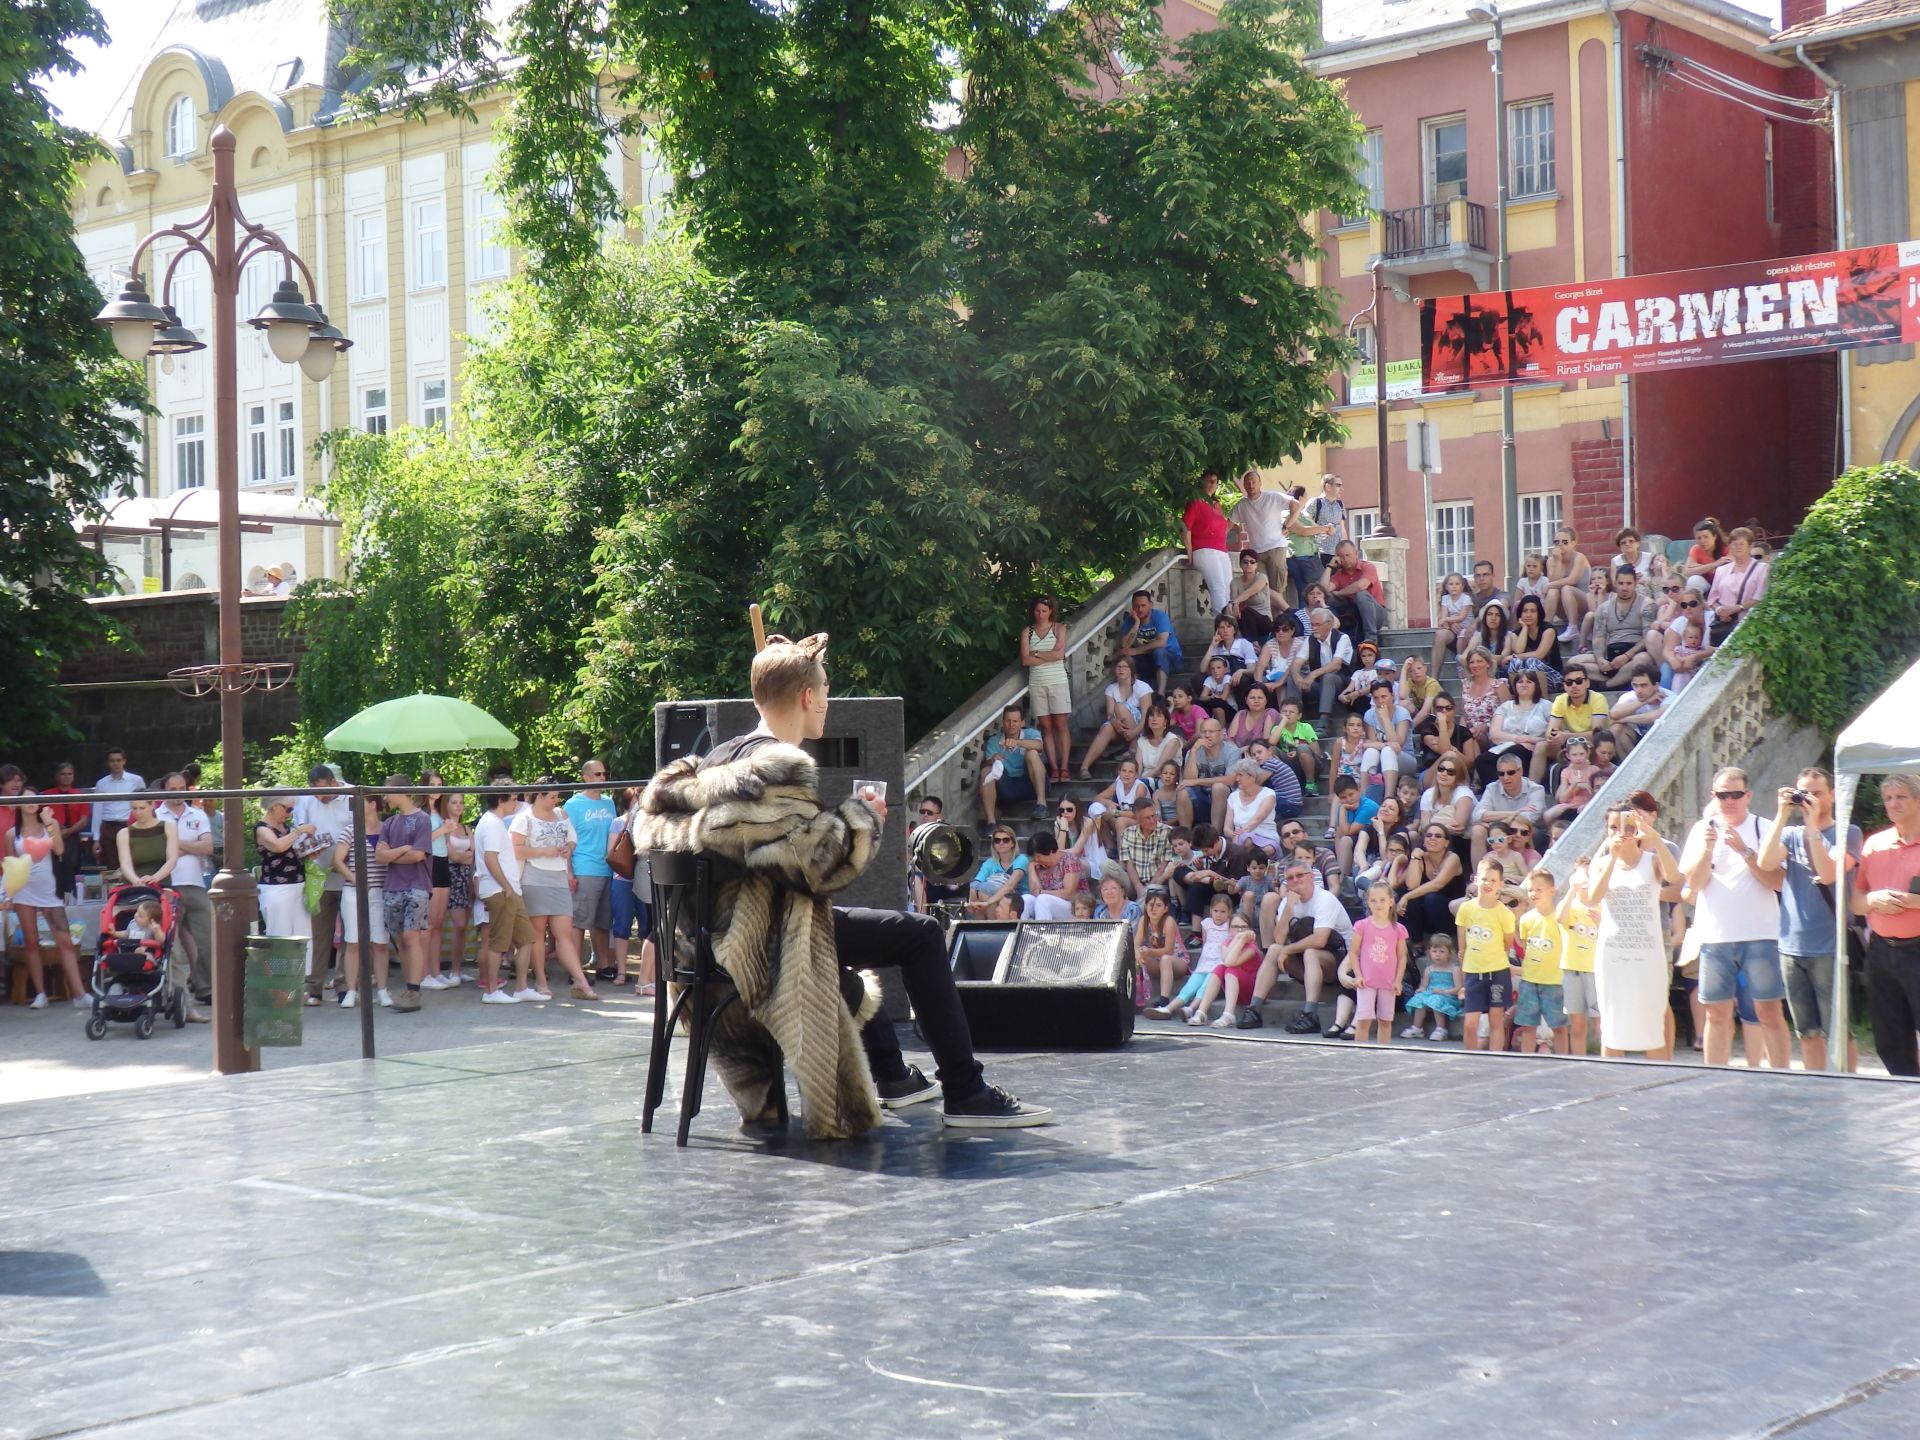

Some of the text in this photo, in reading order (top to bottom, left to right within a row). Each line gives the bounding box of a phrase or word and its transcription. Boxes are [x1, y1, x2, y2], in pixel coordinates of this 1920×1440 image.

[1766, 261, 1836, 277] opera két részben
[1554, 288, 1603, 300] Georges Bizet
[1555, 276, 1839, 354] CARMEN
[1556, 361, 1622, 375] Rinat Shaham
